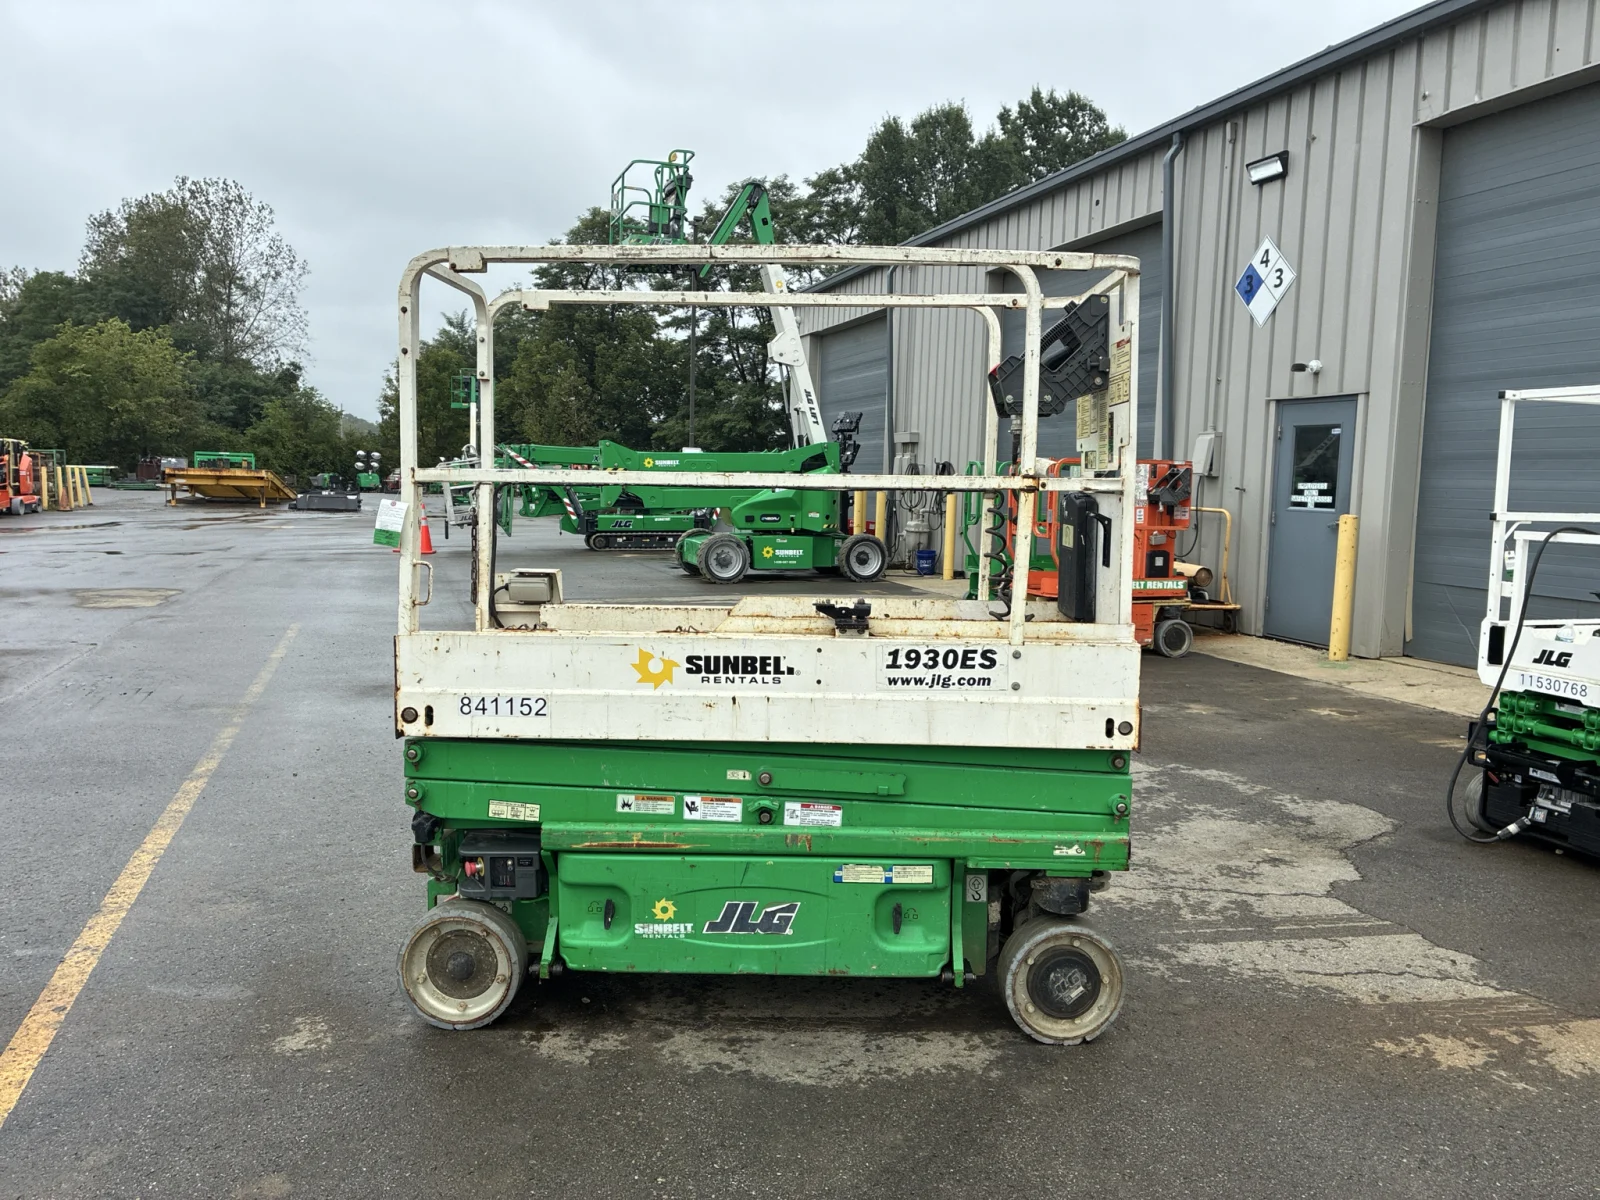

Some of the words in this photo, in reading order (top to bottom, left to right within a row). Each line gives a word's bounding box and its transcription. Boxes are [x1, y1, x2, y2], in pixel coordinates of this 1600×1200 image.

[1260, 248, 1270, 268] 4
[1244, 274, 1254, 294] 3
[1273, 267, 1284, 288] 3
[804, 388, 814, 405] JLG
[809, 406, 820, 426] LIFT
[610, 519, 634, 529] JLG
[1146, 581, 1184, 590] RENTALS
[686, 655, 795, 675] SUNBEL
[886, 648, 998, 670] 1930ES
[1532, 649, 1574, 668] JLG
[701, 676, 782, 684] RENTALS
[887, 674, 992, 689] www.jlg.com
[1520, 673, 1588, 698] 11530768
[460, 696, 547, 716] 841152
[702, 901, 801, 935] JLG
[634, 923, 694, 935] SUNBELT
